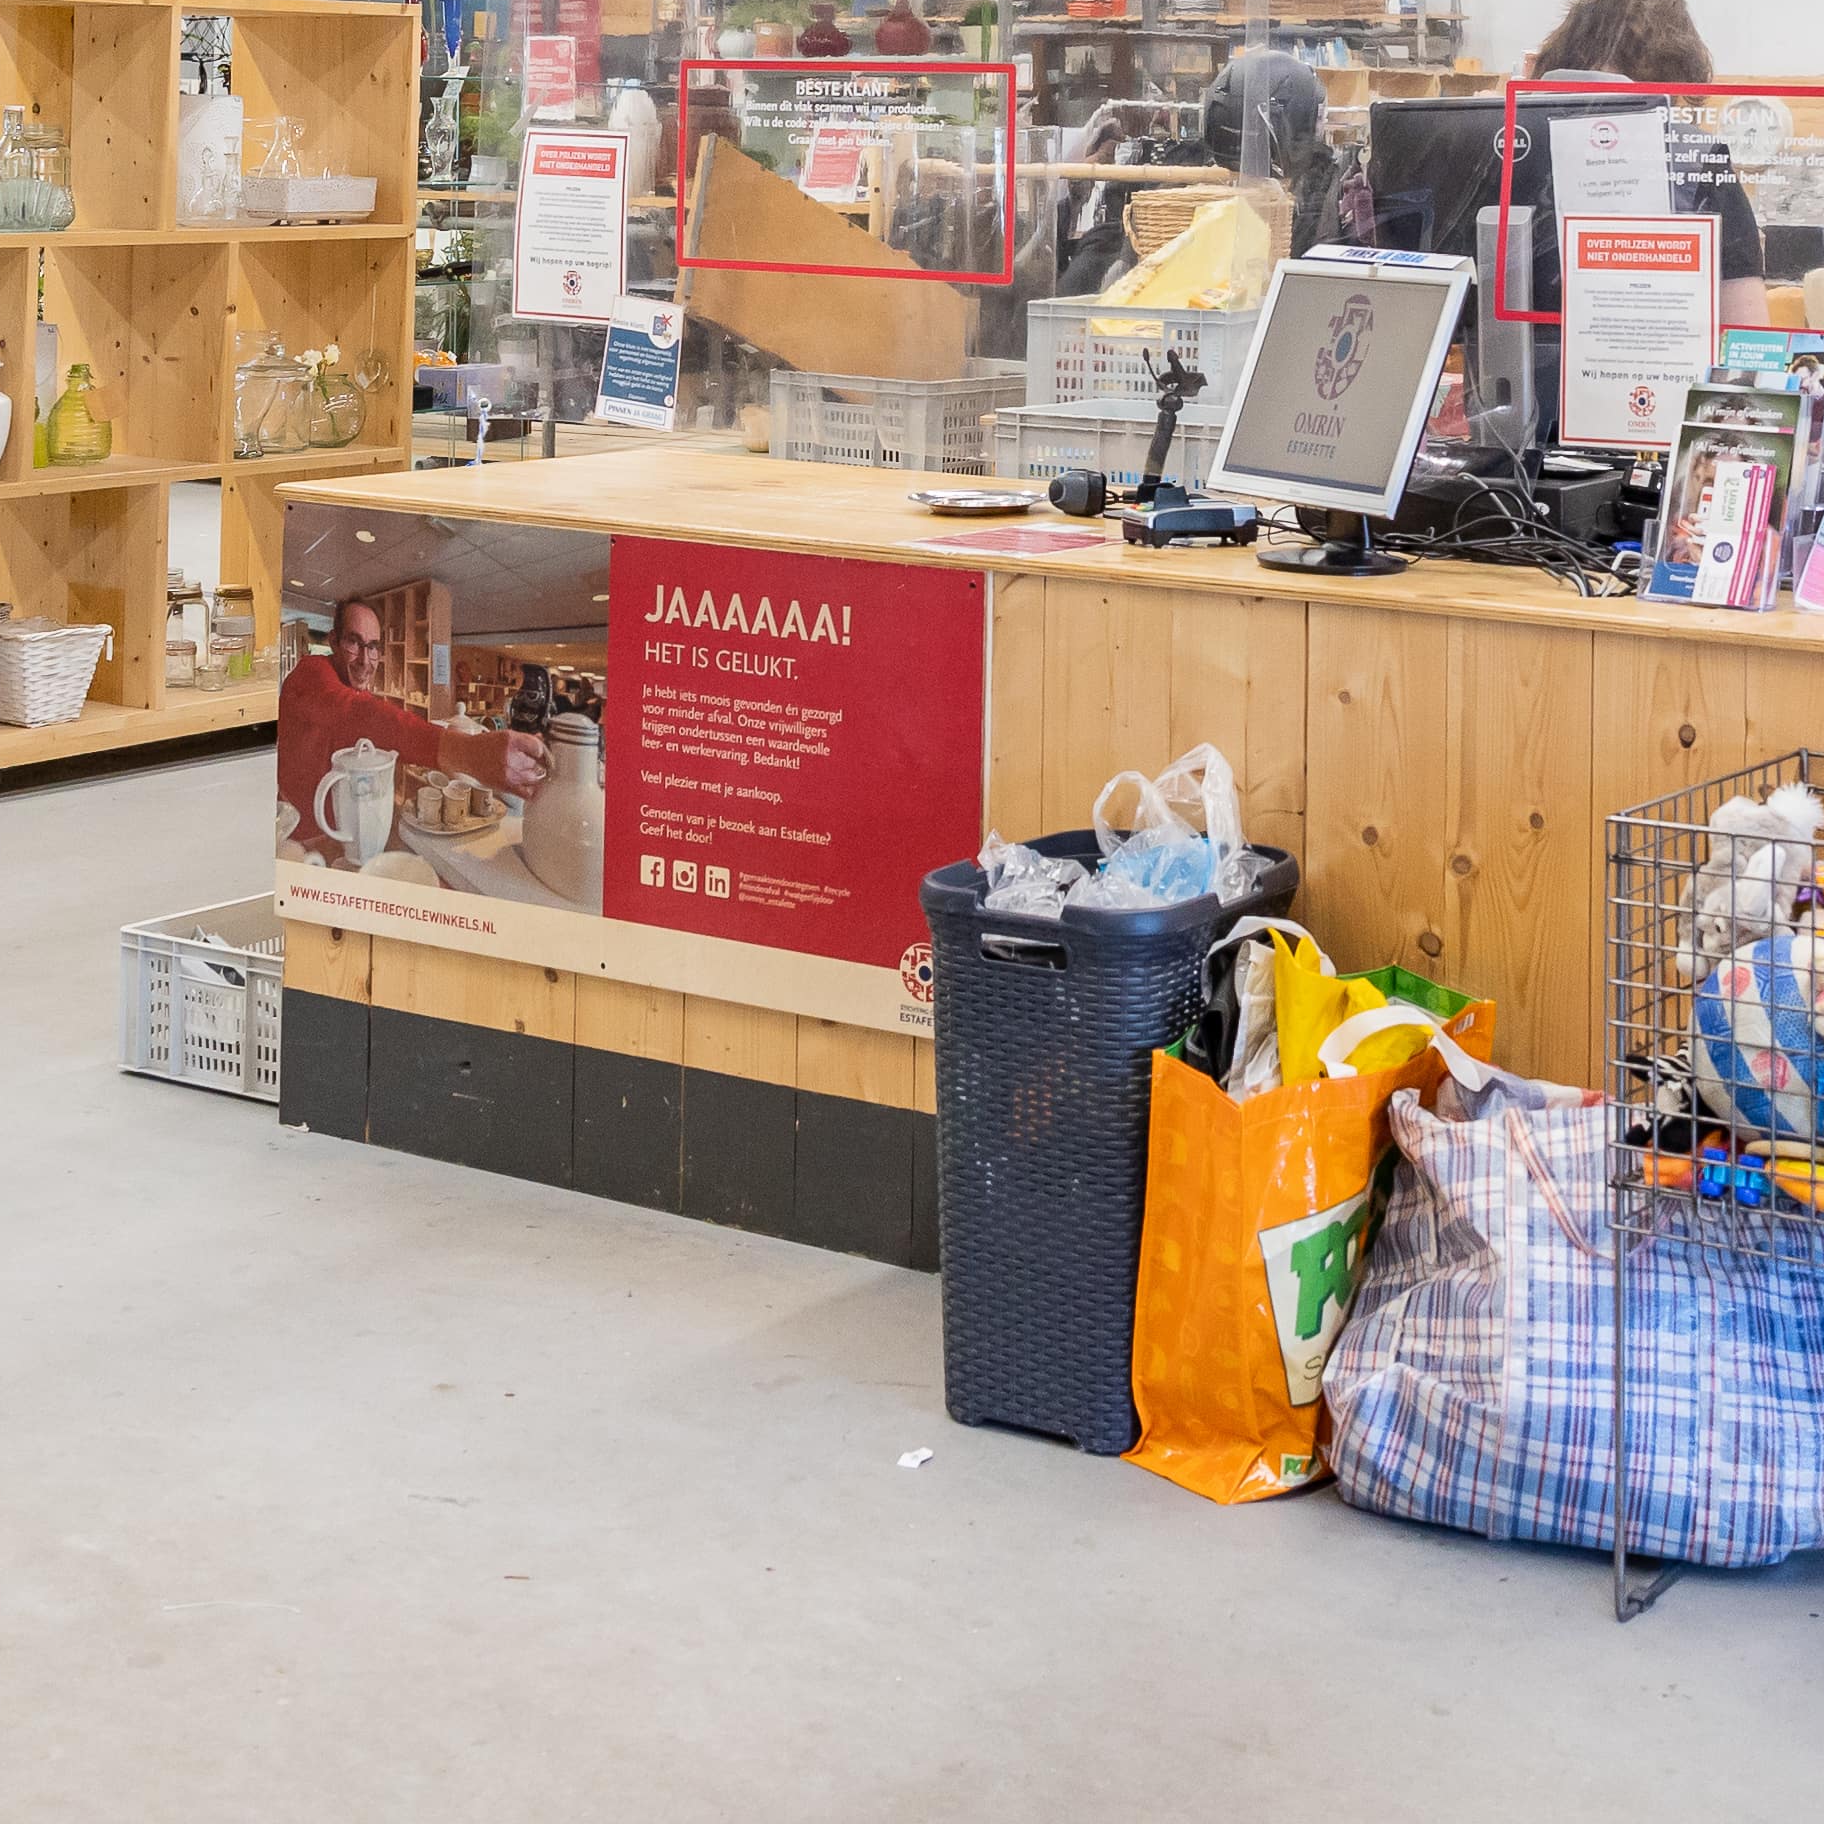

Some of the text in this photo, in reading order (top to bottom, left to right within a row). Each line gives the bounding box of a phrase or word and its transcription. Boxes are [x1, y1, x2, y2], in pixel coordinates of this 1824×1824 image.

[795, 79, 890, 97] BESTE KLANT
[745, 100, 940, 118] Binnen dit vlak scannen wij uw producten.
[1656, 106, 1717, 125] BESTE
[743, 116, 762, 128] Wilt
[763, 119, 770, 128] u
[771, 117, 784, 128] de
[784, 117, 807, 129] code
[1497, 138, 1526, 150] DLL
[1682, 133, 1736, 145] scannen
[1674, 149, 1699, 164] zelf
[1700, 152, 1730, 164] naar
[1687, 170, 1714, 184] met
[1715, 170, 1738, 186] pin
[1587, 239, 1692, 251] OVER PRIJZEN WORDT
[1587, 251, 1692, 264] NIET ONDERHANDELD
[1581, 369, 1699, 384] Wij hopen op uw begrip!
[644, 584, 853, 647] JAAAAAA!
[644, 640, 799, 681] HET IS GELUKT.
[642, 683, 843, 726] Je hebt iets moois gevonden én gezorgd
[642, 704, 828, 739] voor minder afval. Onze vrijwilligers
[642, 718, 831, 757] krijgen ondertussen een waardevolle
[641, 736, 801, 770] leer- en werkervaring. Bedankt!
[640, 770, 784, 805] Veel plezier met je aankoop.
[640, 804, 832, 846] Genoten van je bezoek aan Estafette?
[640, 822, 713, 845] Geef het door!
[824, 885, 852, 898] #recycle
[290, 884, 497, 935] WWW.ESTAFETTERECYCLEWINKELS.NL
[900, 1012, 935, 1027] ESTAFE
